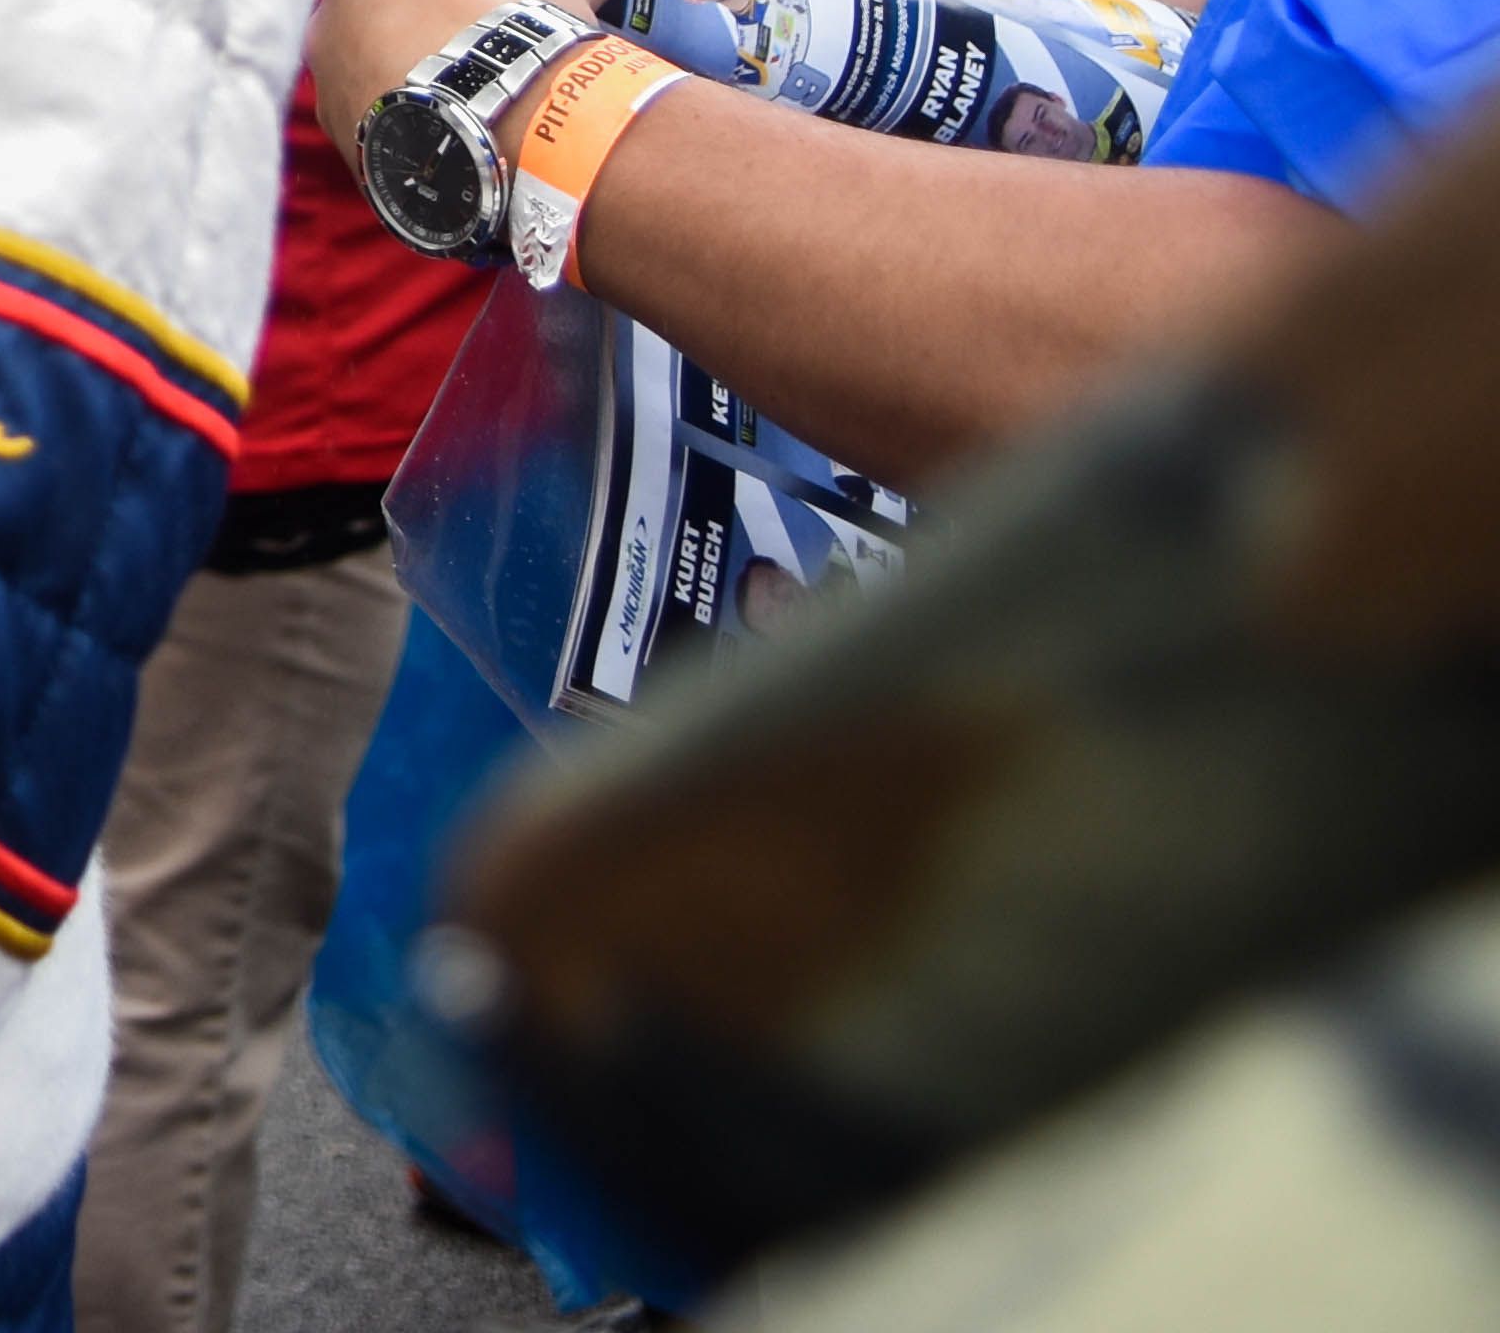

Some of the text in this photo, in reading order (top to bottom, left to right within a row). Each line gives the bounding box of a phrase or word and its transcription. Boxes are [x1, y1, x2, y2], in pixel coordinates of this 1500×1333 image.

[919, 44, 961, 120] RYAN
[932, 38, 989, 145] BLANEY
[618, 539, 649, 637] MICHIGAN
[673, 518, 702, 605] KURT
[693, 519, 726, 626] BUSCH
